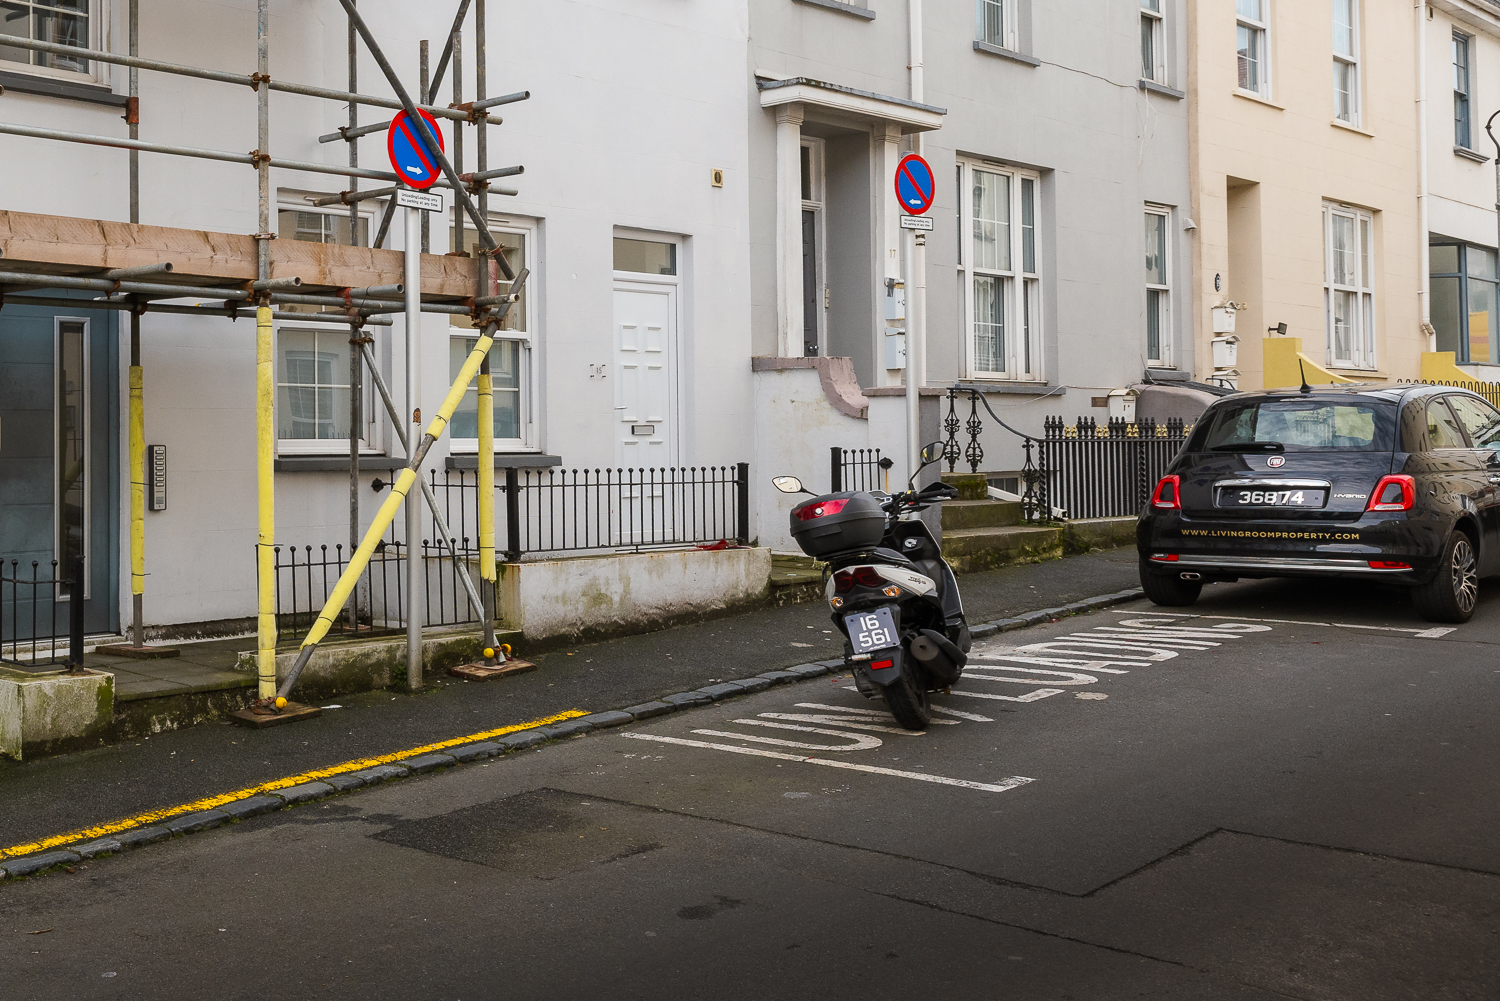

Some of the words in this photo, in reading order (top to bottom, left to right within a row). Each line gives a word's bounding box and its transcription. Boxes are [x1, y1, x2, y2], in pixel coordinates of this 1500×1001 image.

[1238, 490, 1305, 505] 36874
[1181, 529, 1360, 540] WWW.LIVINGROOMPROPERTY.COM
[859, 614, 880, 631] 16
[858, 627, 892, 647] 561
